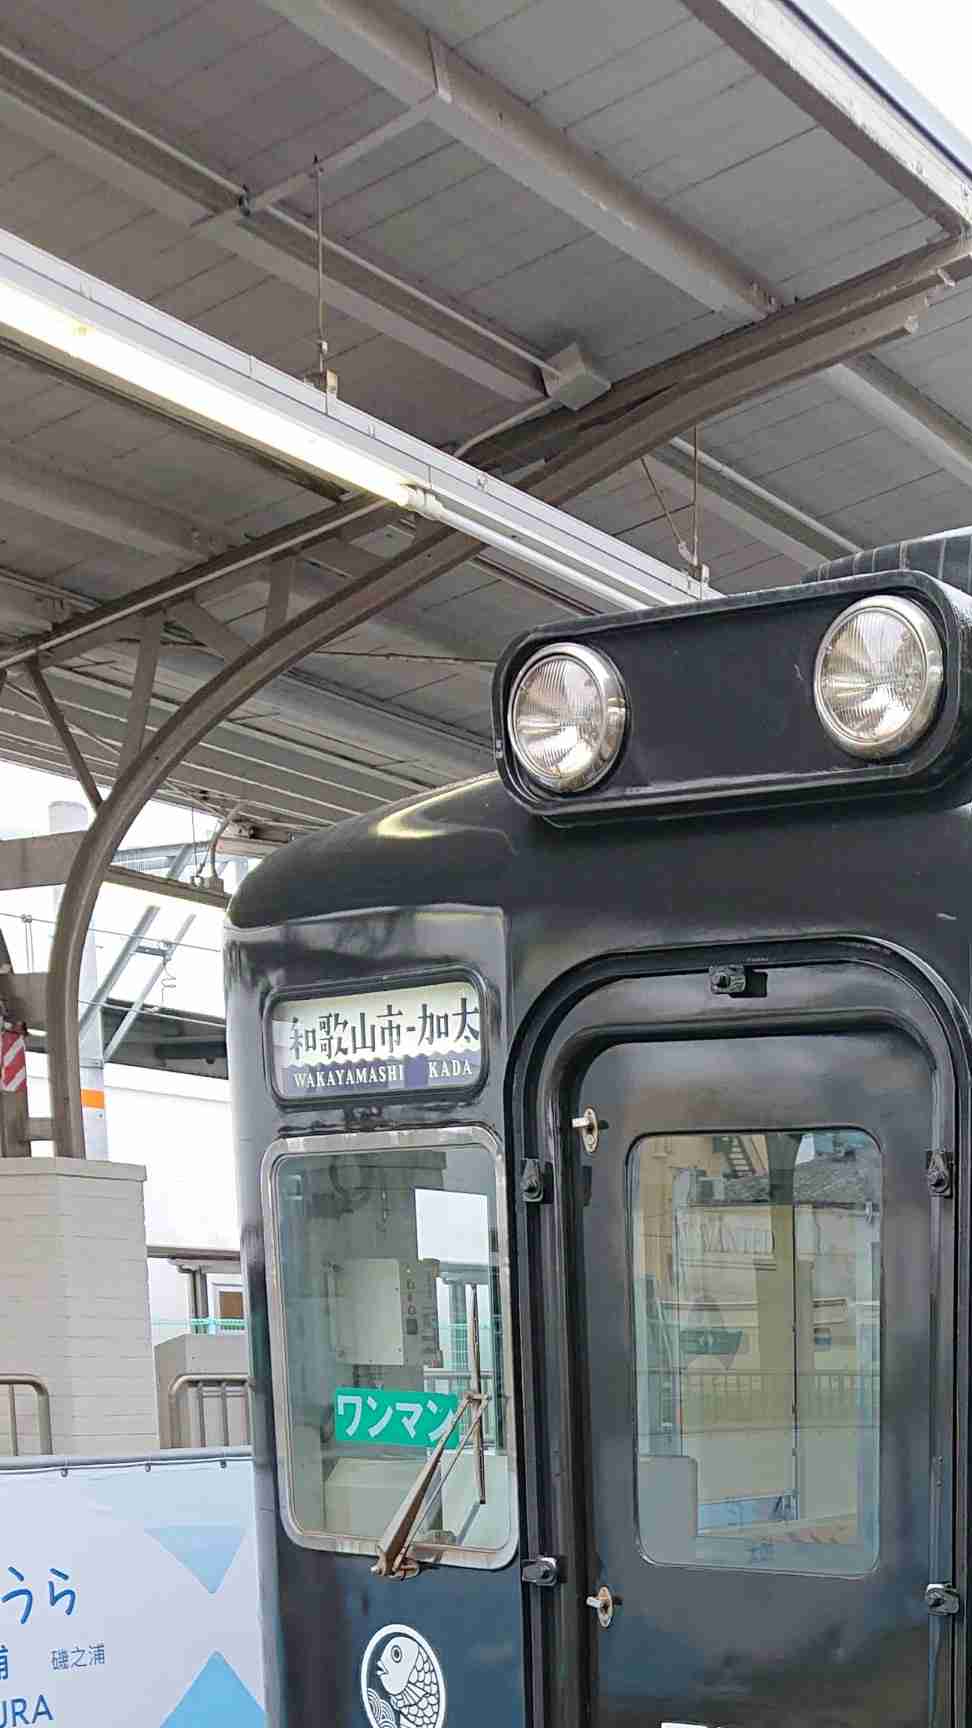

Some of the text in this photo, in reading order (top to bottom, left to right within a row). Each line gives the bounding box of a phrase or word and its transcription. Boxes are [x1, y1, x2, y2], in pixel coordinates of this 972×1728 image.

[293, 1058, 473, 1089] WAKAYAMASHI KADA
[336, 1395, 455, 1443] ワンマン
[51, 1643, 105, 1671] 磯之浦
